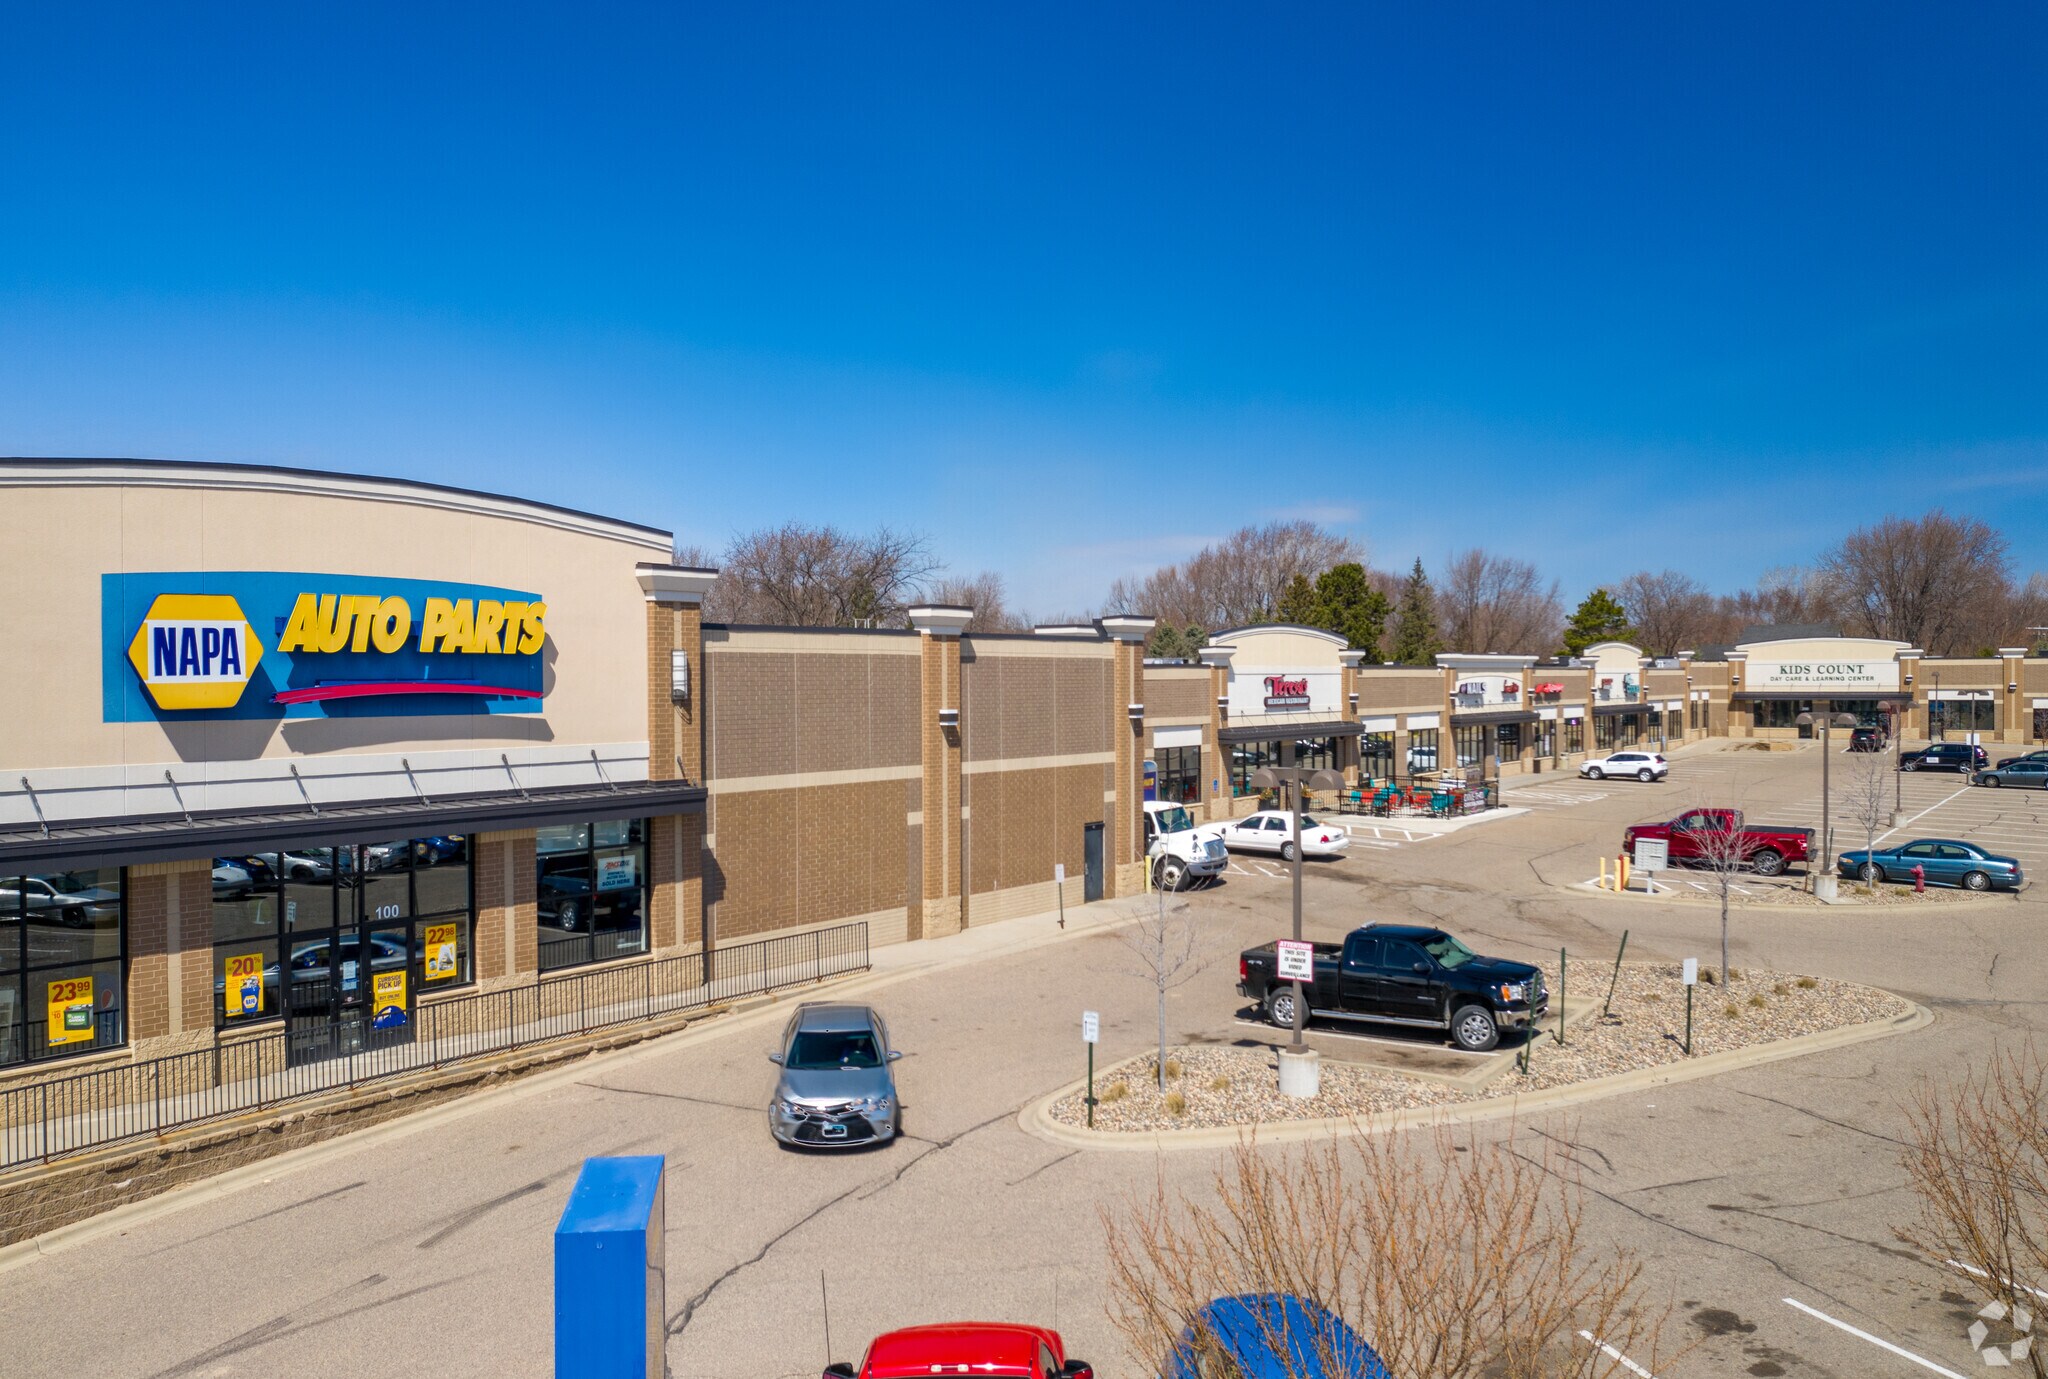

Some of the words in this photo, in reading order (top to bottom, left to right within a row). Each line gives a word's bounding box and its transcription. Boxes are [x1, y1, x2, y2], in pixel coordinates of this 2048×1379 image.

[277, 592, 411, 654] AUTO
[419, 596, 548, 655] PARTS
[152, 626, 242, 677] NAPA
[1780, 665, 1811, 675] KIDS
[1817, 664, 1864, 675] COUNT
[376, 904, 399, 920] 100
[1279, 940, 1312, 950] ATTENTION
[378, 981, 392, 990] PICK
